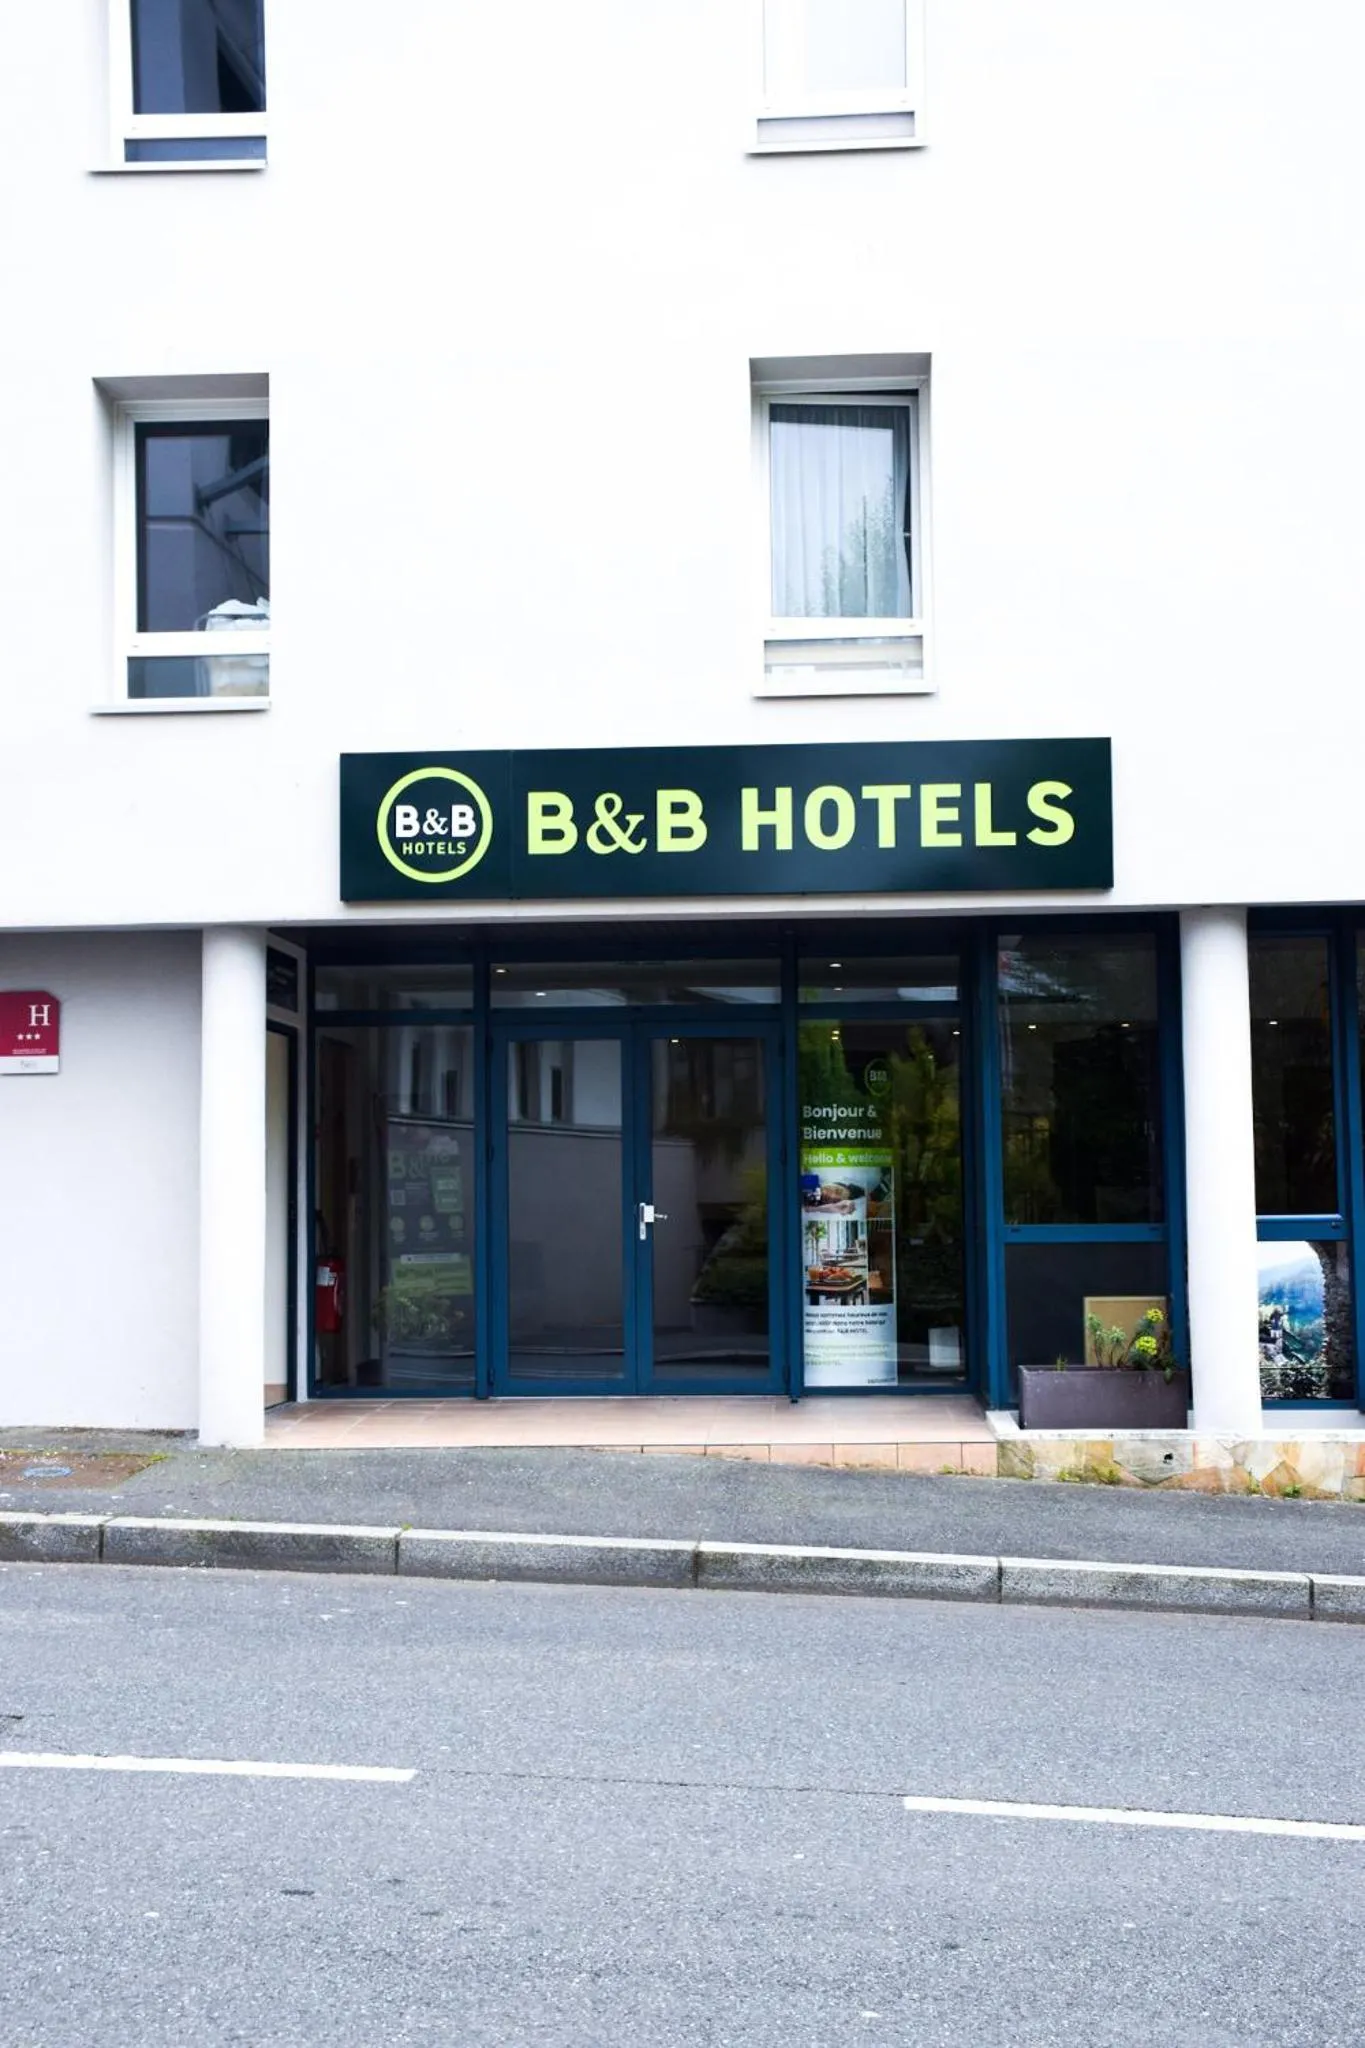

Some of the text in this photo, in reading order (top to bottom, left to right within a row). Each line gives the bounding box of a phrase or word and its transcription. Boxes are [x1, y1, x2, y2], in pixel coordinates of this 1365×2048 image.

[395, 804, 477, 838] B&B
[527, 780, 1075, 856] B&B HOTELS
[402, 841, 467, 855] HOTELS
[28, 1004, 51, 1027] H
[803, 1103, 878, 1122] Bonjour &
[803, 1125, 882, 1140] Bienvenue
